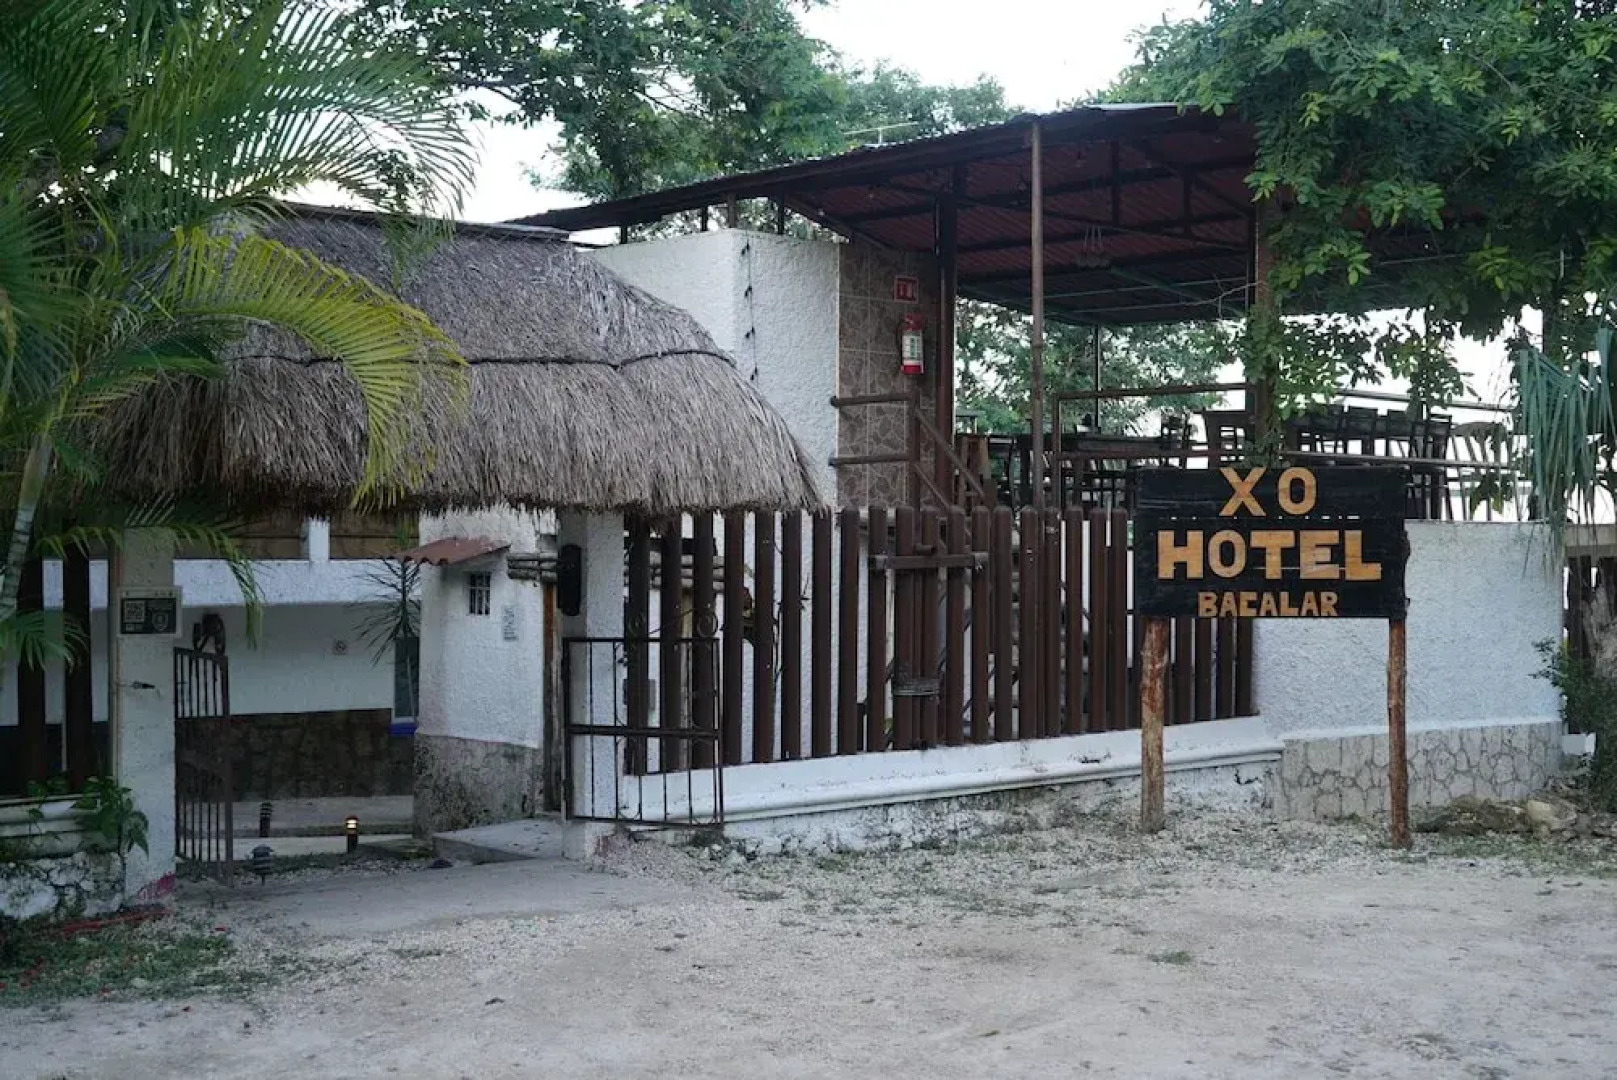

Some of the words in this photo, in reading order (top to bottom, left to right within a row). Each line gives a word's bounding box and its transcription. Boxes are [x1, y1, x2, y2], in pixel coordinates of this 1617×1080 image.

[1219, 466, 1316, 516] XO
[1157, 530, 1382, 580] HOTEL
[1197, 591, 1339, 616] BACALAR
